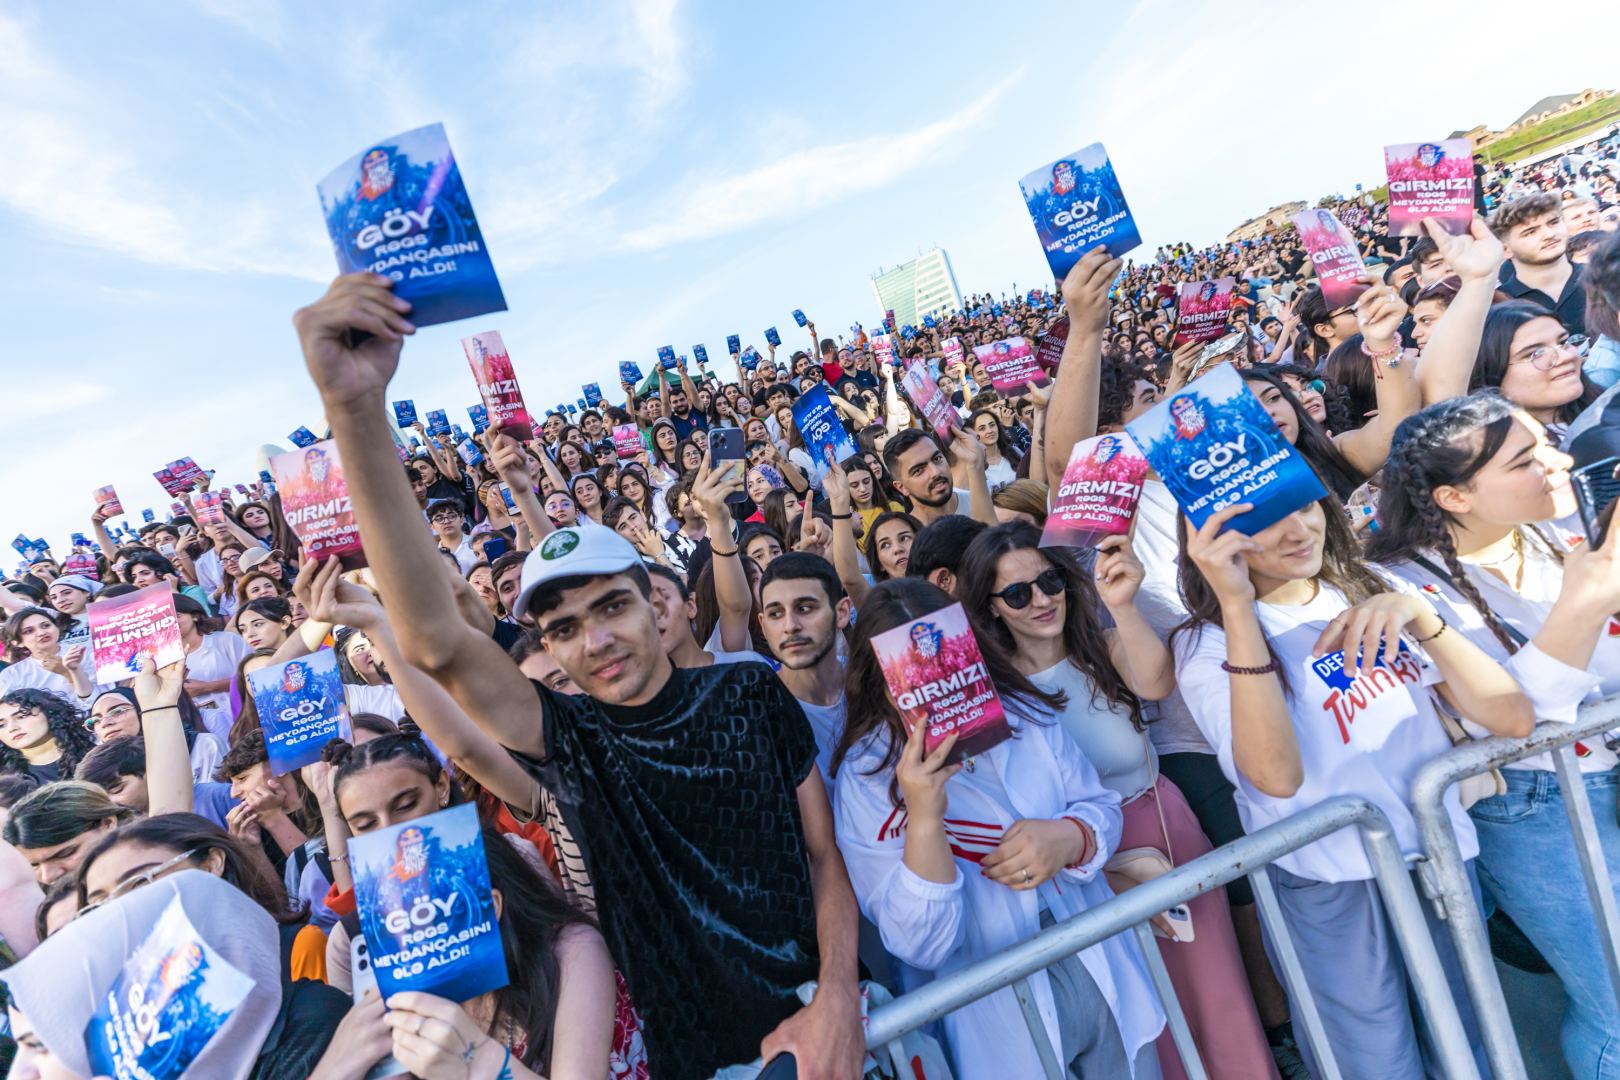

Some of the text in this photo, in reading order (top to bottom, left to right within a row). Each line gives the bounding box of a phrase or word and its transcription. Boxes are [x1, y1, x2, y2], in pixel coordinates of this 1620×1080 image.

[1389, 178, 1472, 192] QIRMIZI
[1054, 196, 1100, 226] GÖY
[356, 205, 434, 250] GÖY
[985, 354, 1036, 373] QIRMIZI
[811, 422, 831, 444] GÖY
[1188, 433, 1247, 480] GÖY
[1058, 480, 1141, 501] QIRMIZI
[286, 496, 353, 527] QIRMIZ
[94, 616, 176, 649] QIRMIZI
[898, 662, 988, 710] QIRMIZI
[280, 697, 326, 721] GÖY
[385, 892, 458, 934] GÖY
[373, 921, 492, 968] MEYDANÇASINI
